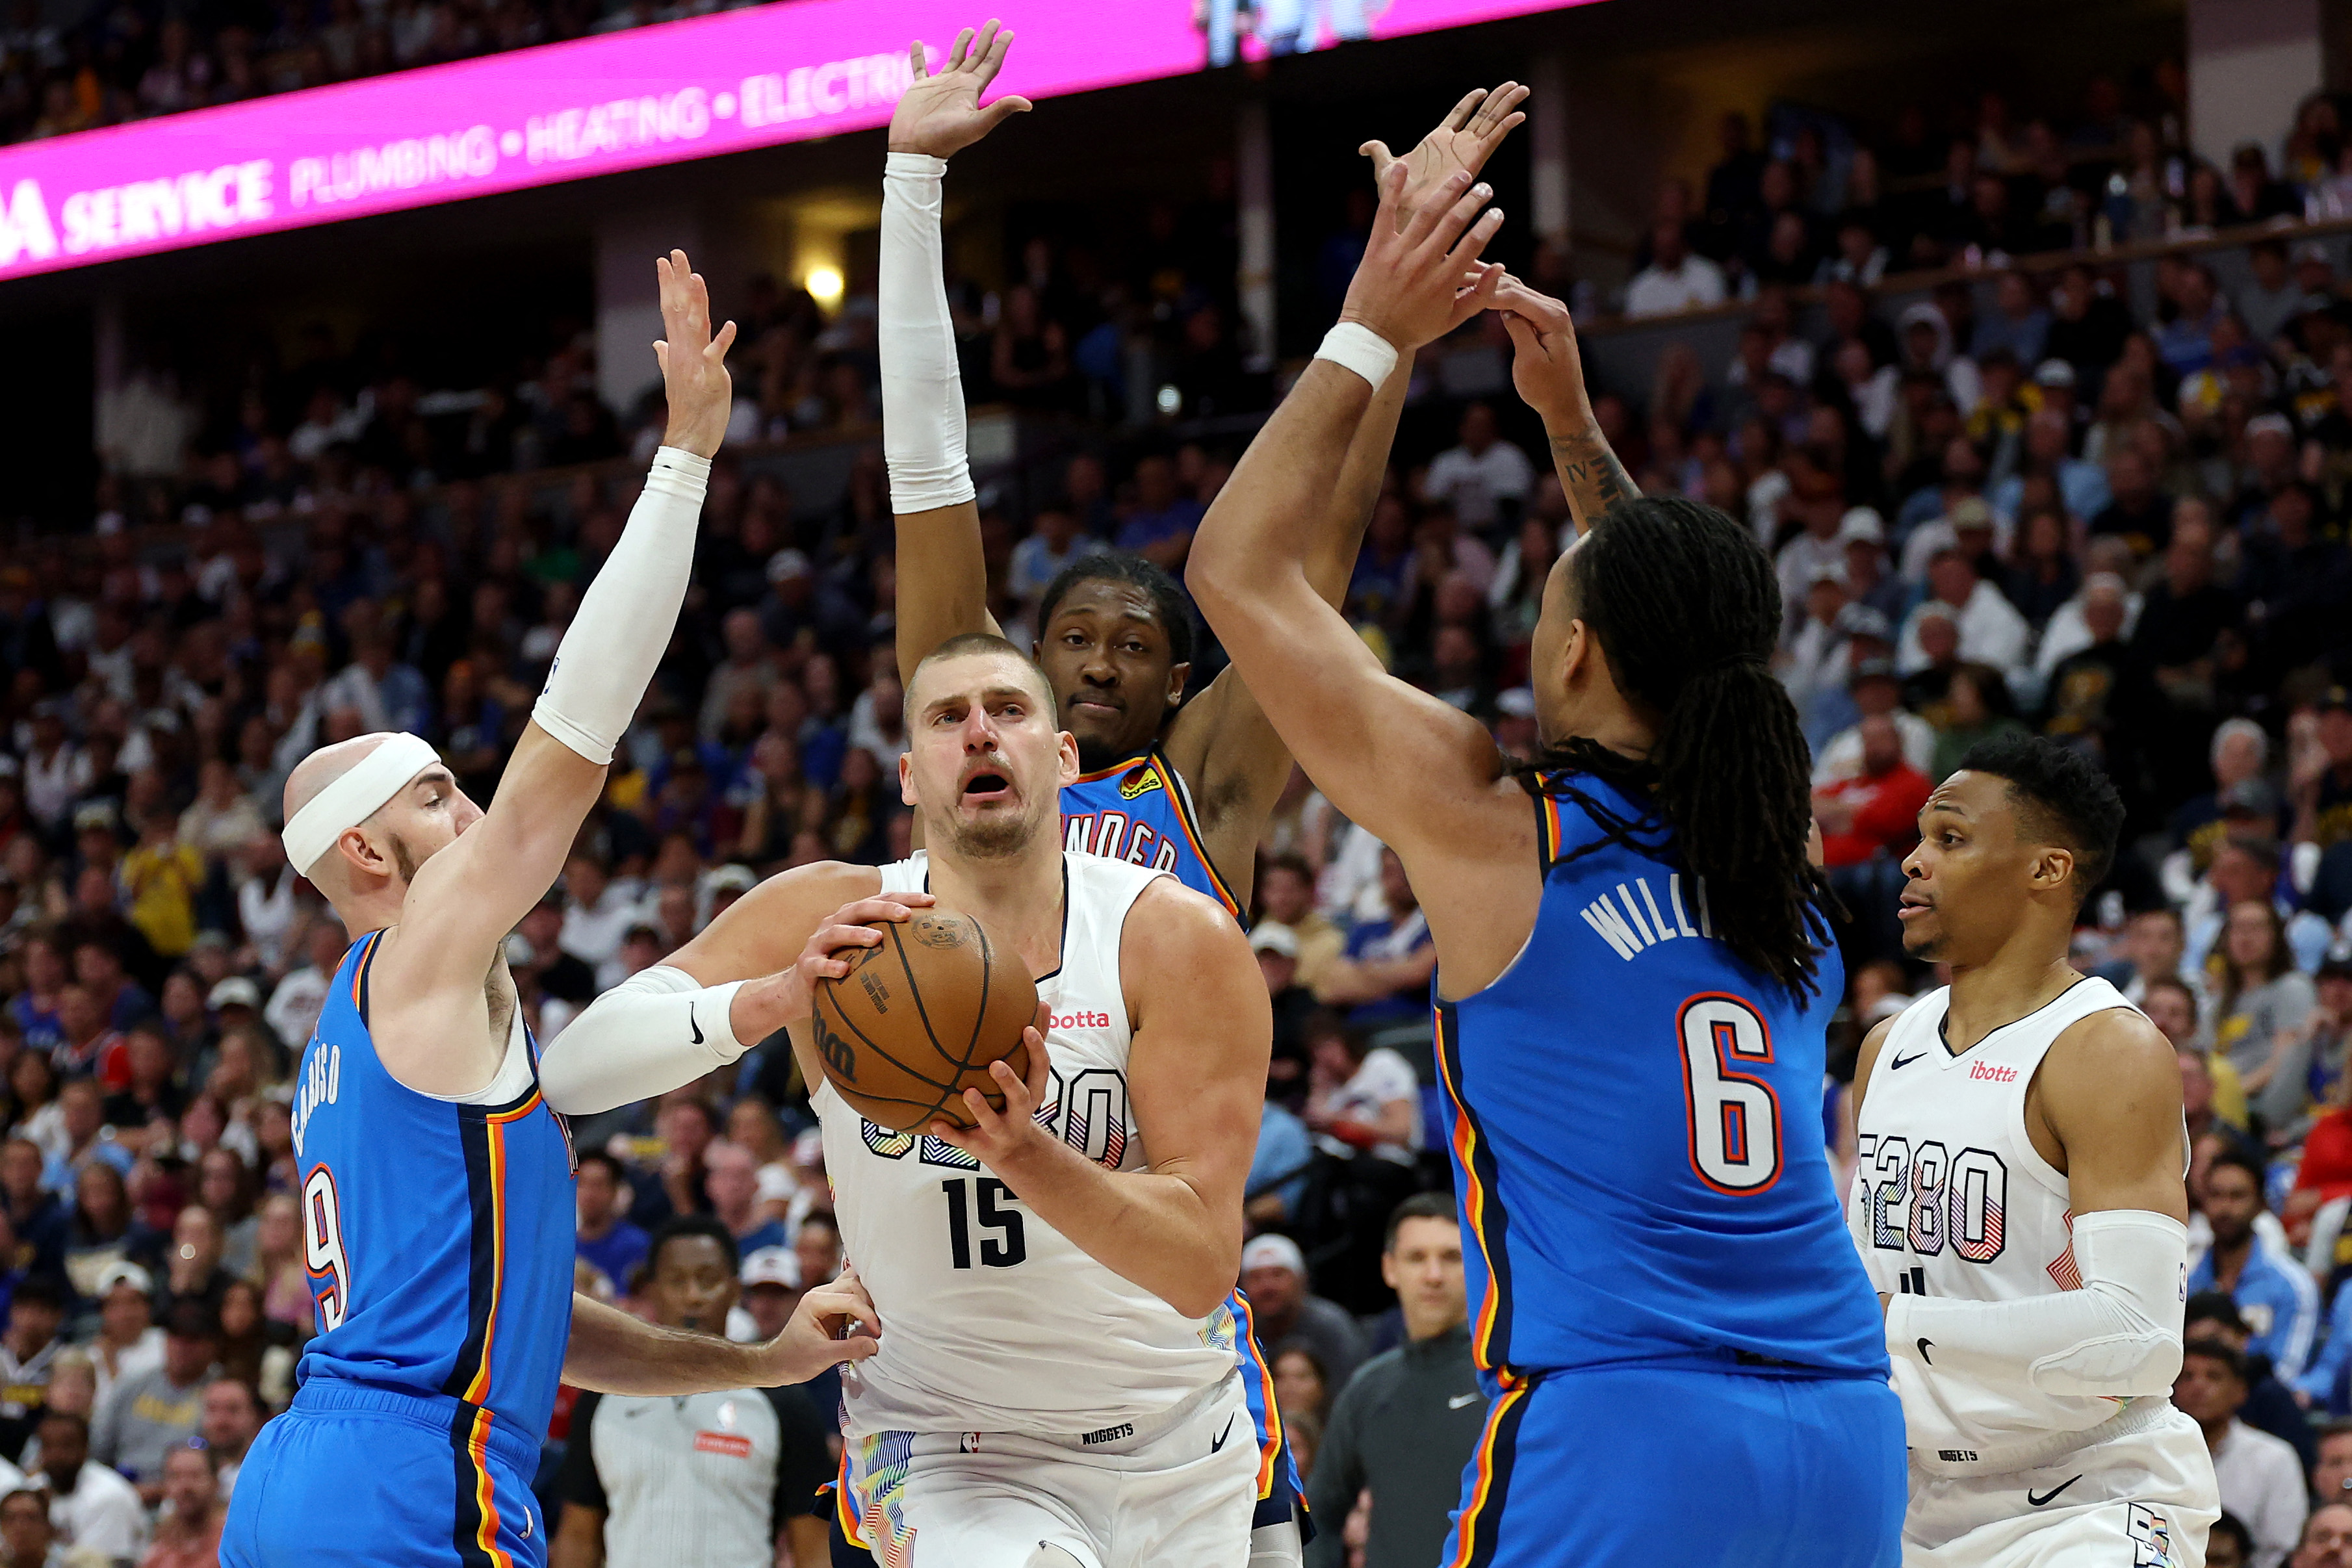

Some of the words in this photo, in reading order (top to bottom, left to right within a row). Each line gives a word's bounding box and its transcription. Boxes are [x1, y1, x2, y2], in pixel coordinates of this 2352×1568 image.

[61, 157, 274, 255] SERVICE
[289, 124, 498, 208] PLUMBING
[526, 86, 710, 164] HEATING
[1061, 810, 1179, 873] NDER
[1580, 873, 1726, 962] WILLI
[291, 1042, 341, 1158] CARUSO
[1675, 991, 1784, 1197] 6
[1969, 1060, 2017, 1083] ibotta
[303, 1161, 350, 1333] 9
[942, 1177, 1027, 1270] 15
[1082, 1422, 1134, 1446] NUGGETS
